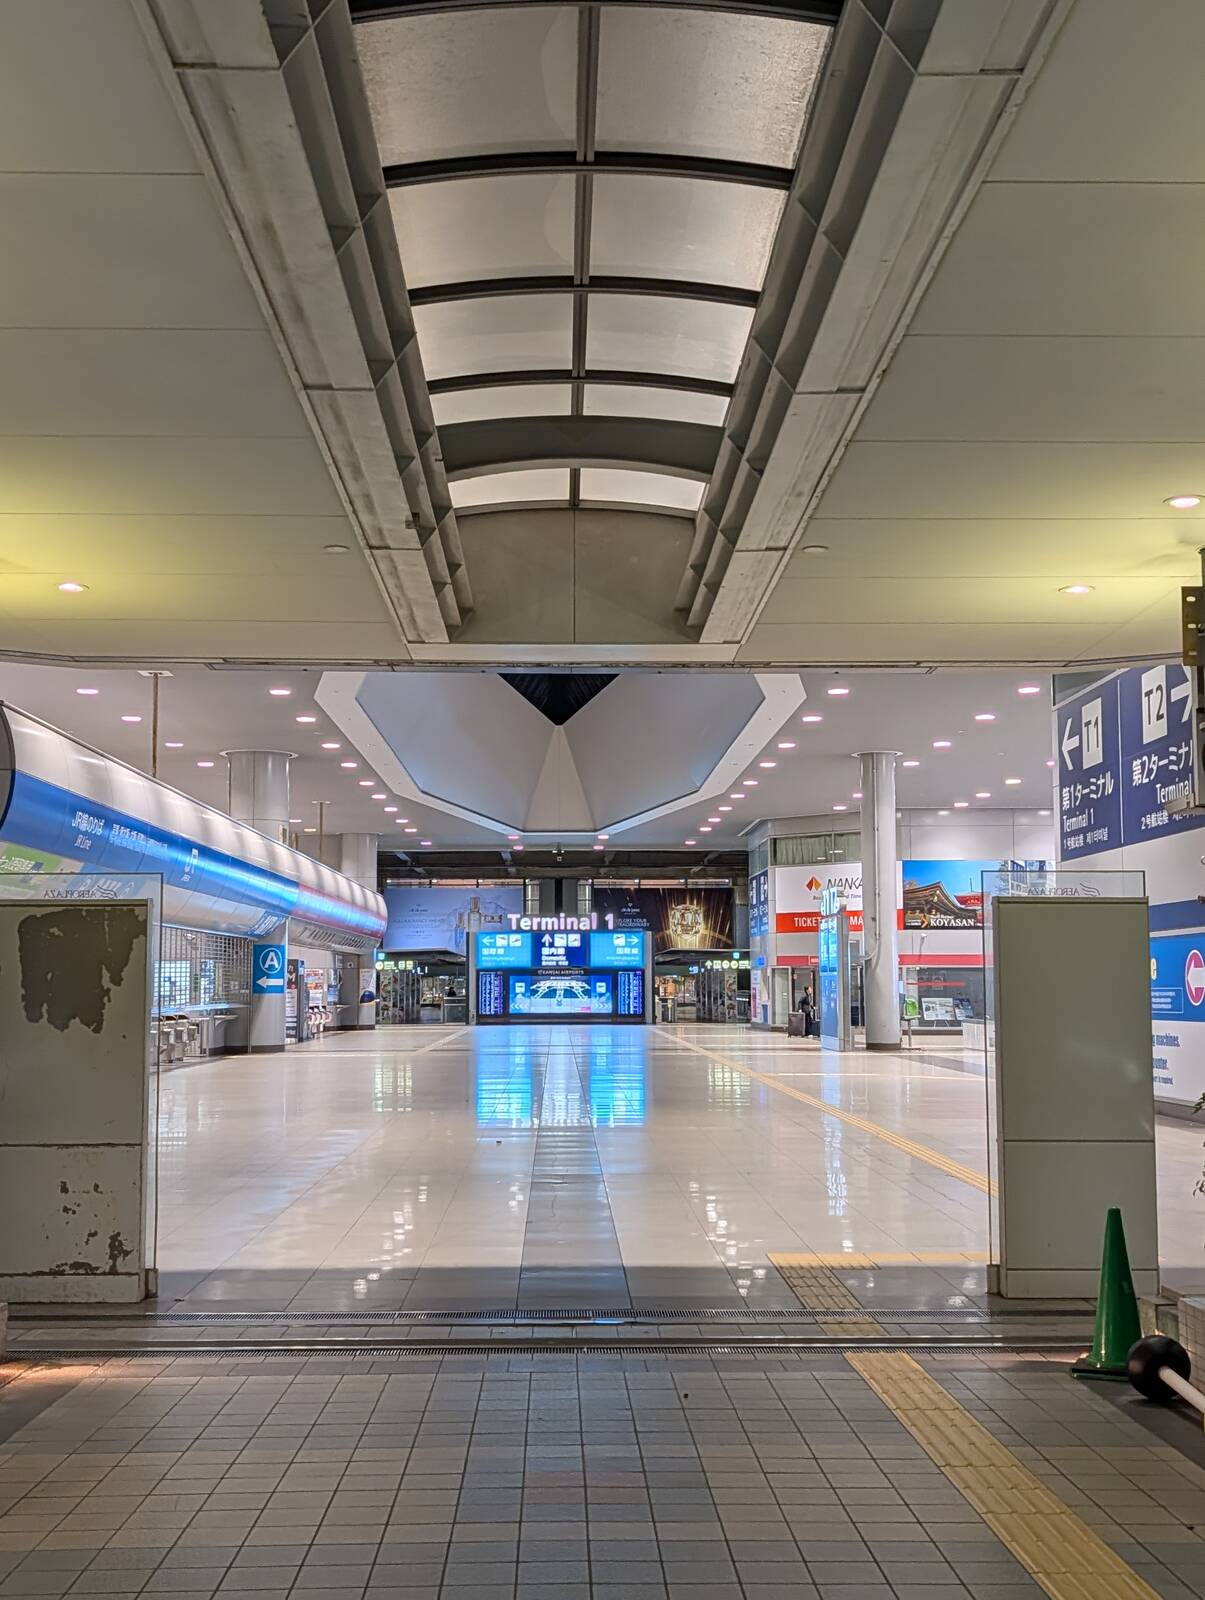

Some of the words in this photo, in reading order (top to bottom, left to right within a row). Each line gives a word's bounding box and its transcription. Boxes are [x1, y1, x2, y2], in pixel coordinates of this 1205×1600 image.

[1144, 684, 1165, 726] T2
[1084, 716, 1100, 753] T1
[1062, 770, 1114, 811] 第1ターミナル
[1156, 773, 1193, 804] Terminal
[1063, 809, 1088, 833] Terminal
[1090, 808, 1095, 824] 1
[507, 912, 598, 931] Terminal
[604, 912, 614, 931] 1
[930, 918, 975, 927] KOYASAN
[263, 951, 279, 969] A
